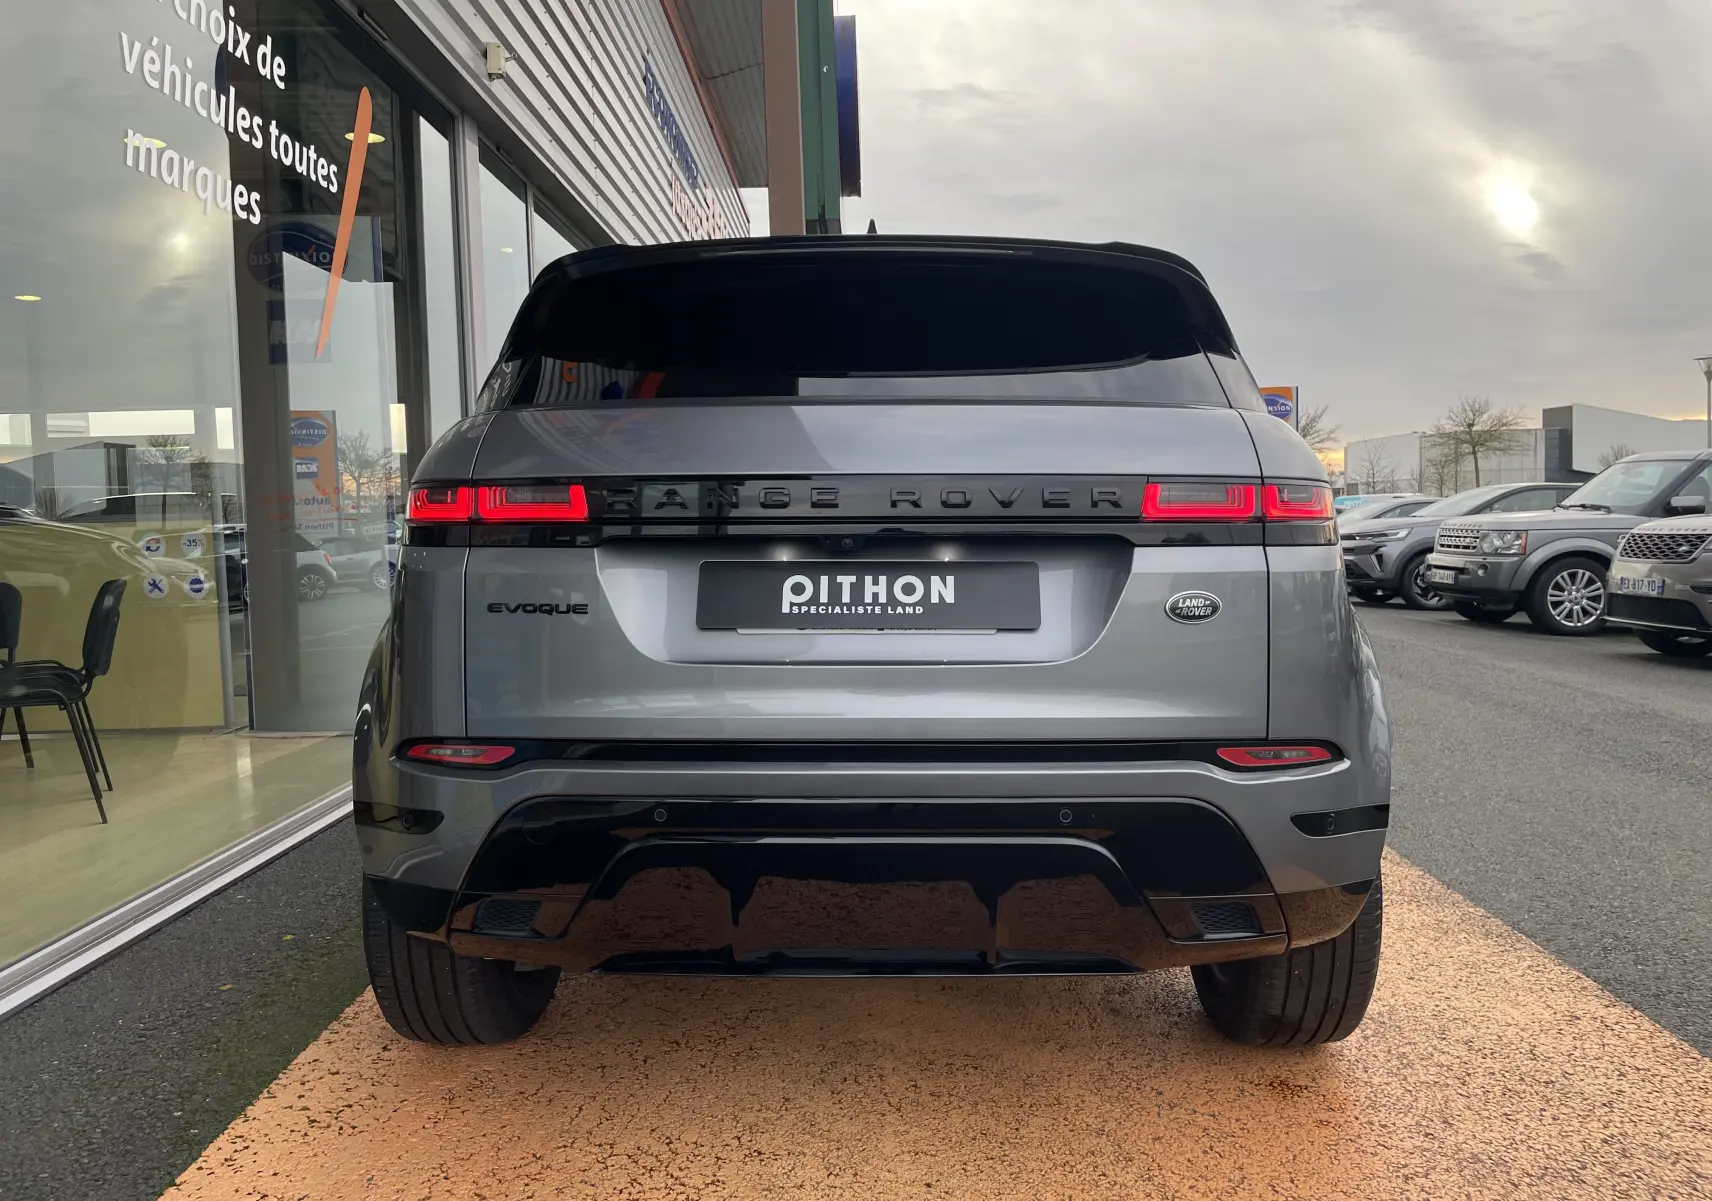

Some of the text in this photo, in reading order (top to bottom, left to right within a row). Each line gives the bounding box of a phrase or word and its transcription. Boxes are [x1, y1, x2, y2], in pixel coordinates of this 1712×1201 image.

[256, 34, 286, 90] de
[120, 31, 338, 193] véhicules toutes
[125, 128, 261, 225] marques
[604, 487, 1123, 510] RANGE ROVER
[782, 574, 955, 613] PITHON
[1179, 598, 1205, 607] LAND
[487, 602, 589, 616] EVOQUE
[791, 605, 924, 614] SPECIALISTE LAND
[1181, 606, 1212, 616] ROVER
